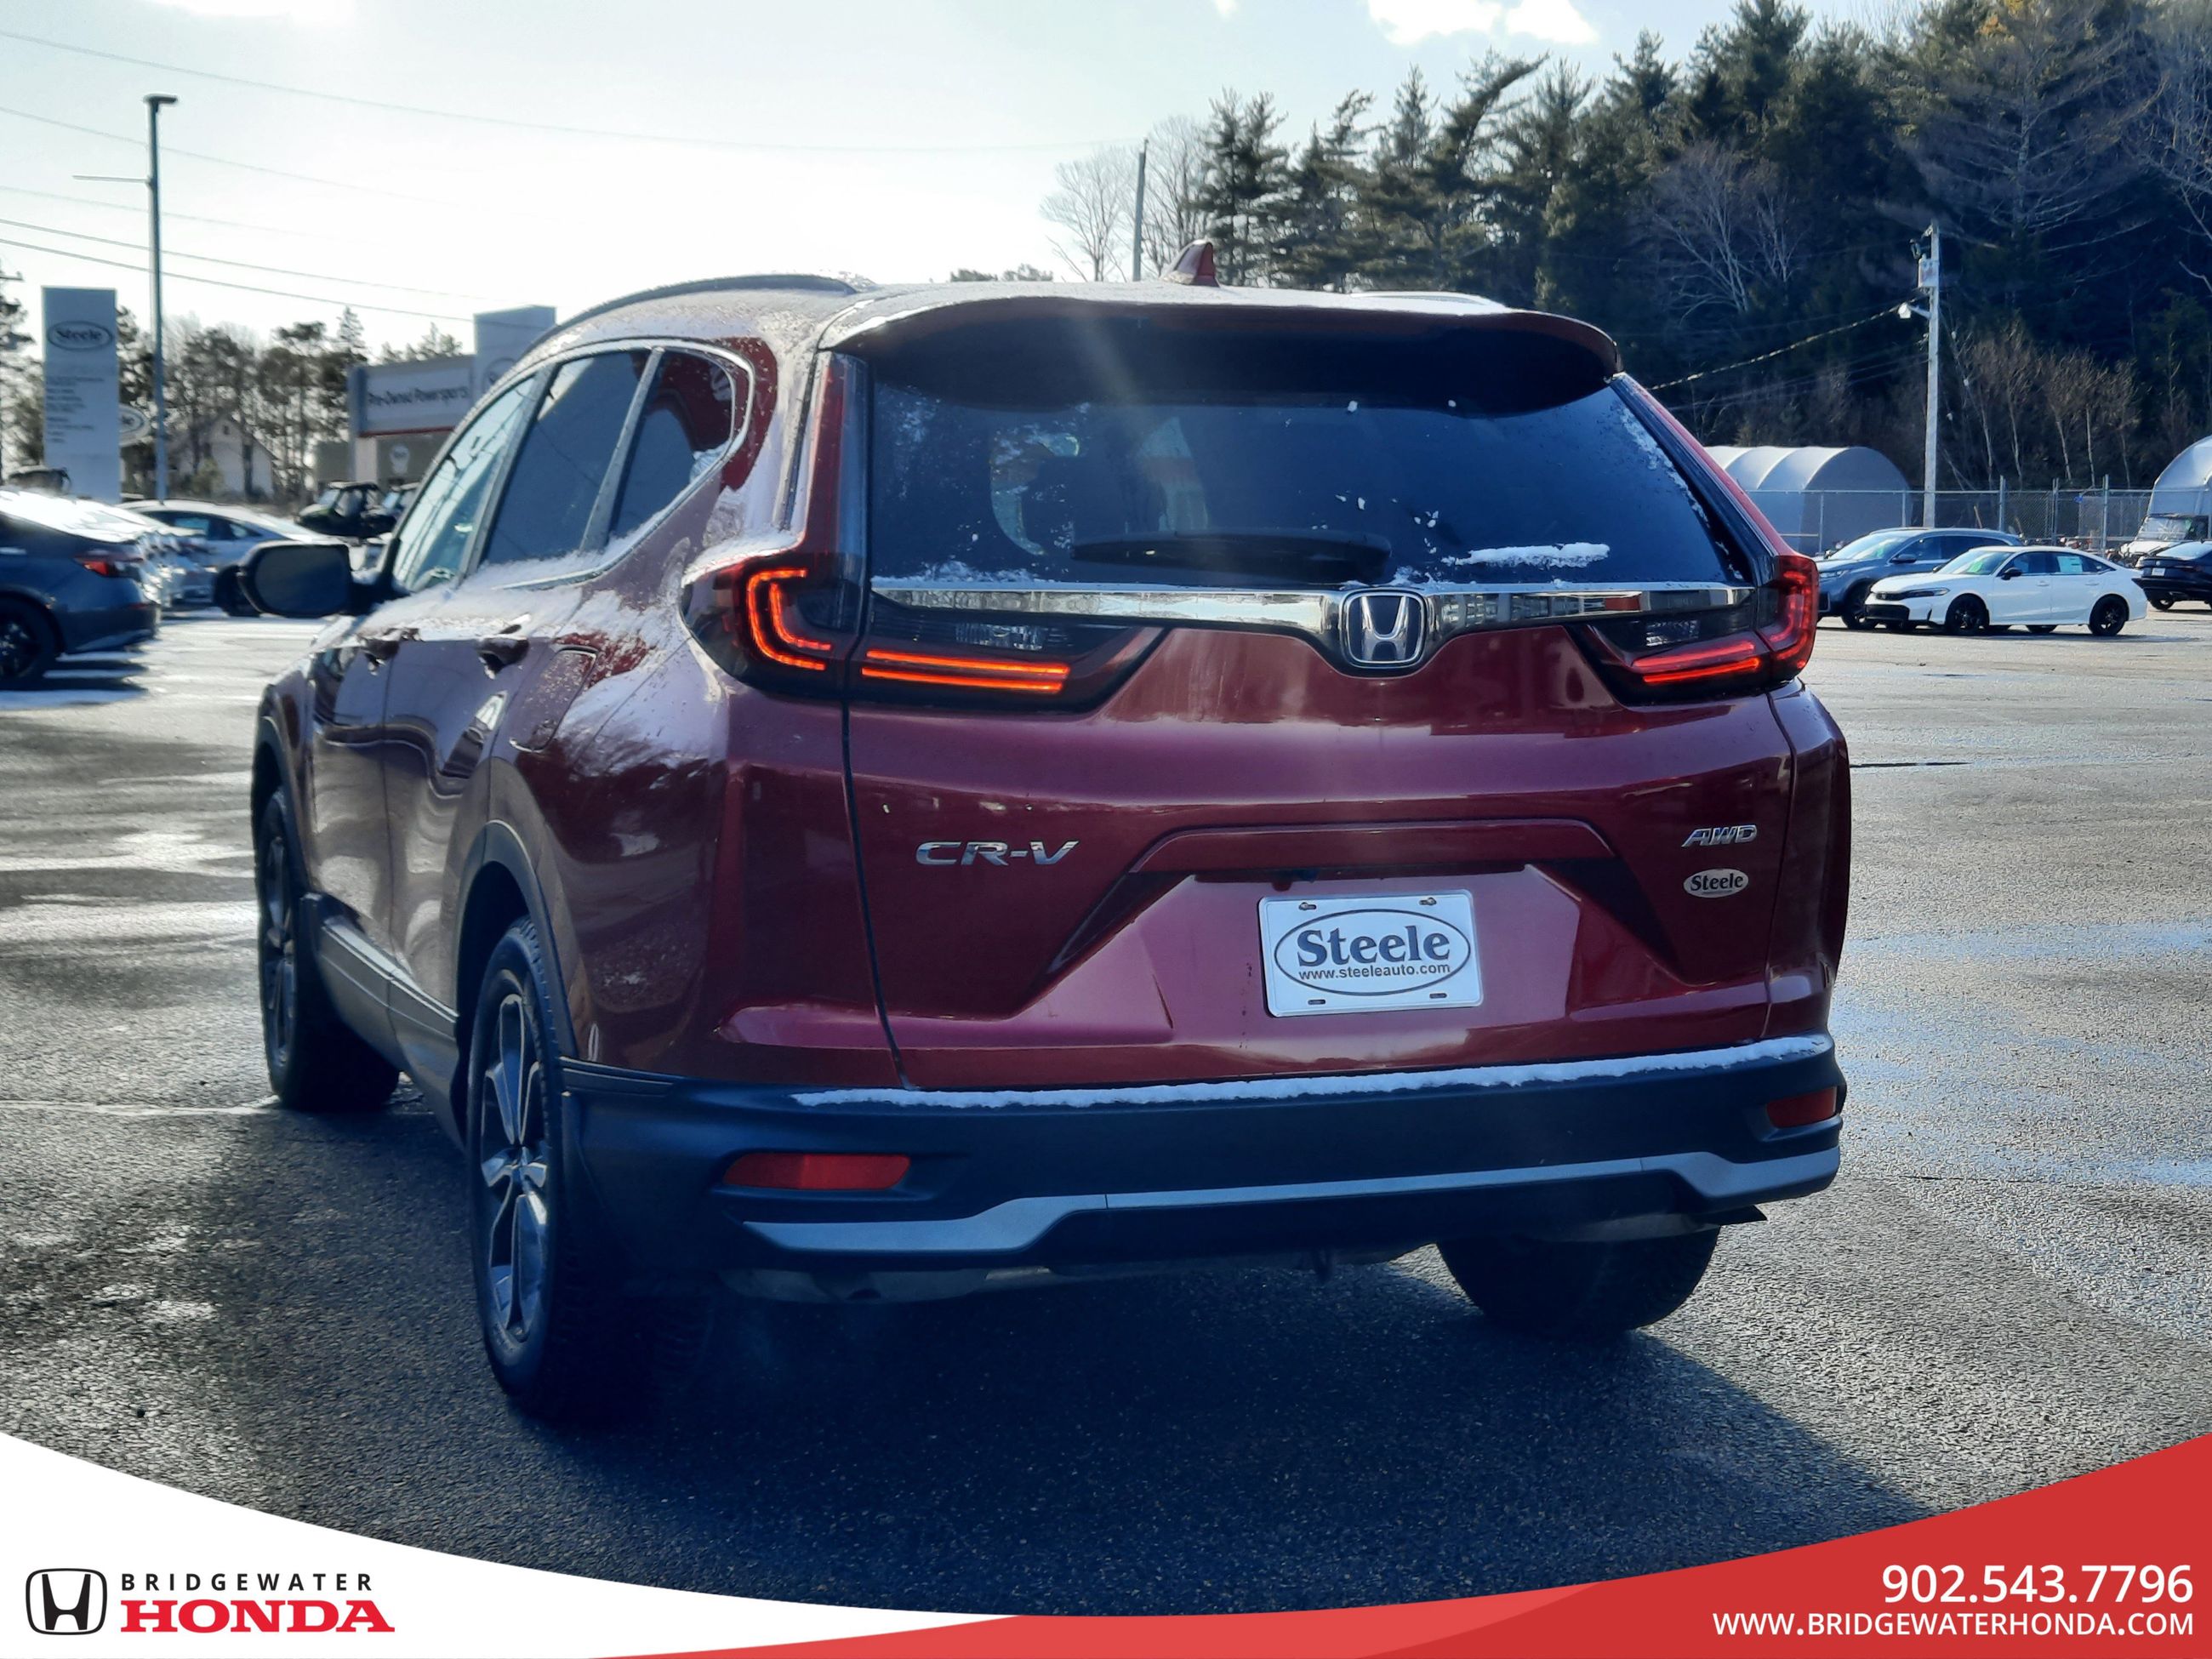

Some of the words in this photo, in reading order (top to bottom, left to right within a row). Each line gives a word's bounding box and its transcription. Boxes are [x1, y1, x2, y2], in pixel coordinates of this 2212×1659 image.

[1681, 824, 1758, 847] AWD
[915, 839, 1080, 866] CR-V
[1690, 872, 1744, 892] Steele
[1297, 925, 1451, 967] Steele
[1298, 962, 1451, 980] www.steeleauto.com
